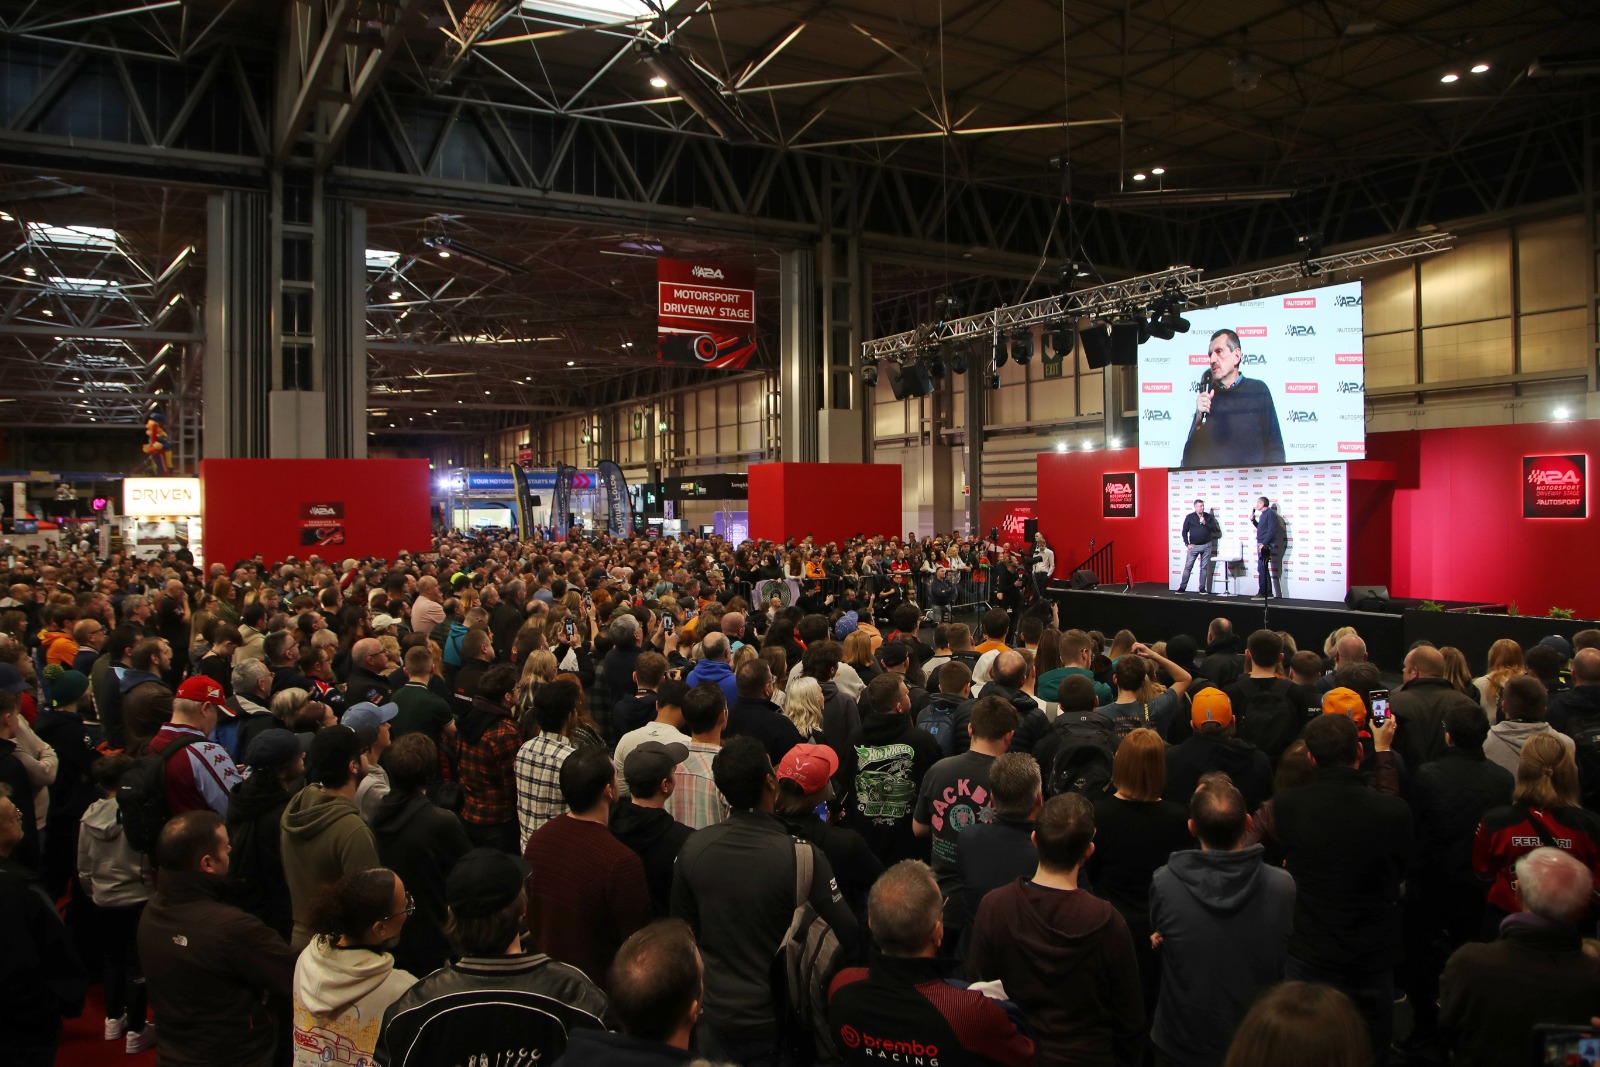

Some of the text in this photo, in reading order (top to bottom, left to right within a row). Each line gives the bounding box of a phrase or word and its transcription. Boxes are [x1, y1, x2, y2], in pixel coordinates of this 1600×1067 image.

[673, 288, 740, 304] MOTORSPORT
[663, 302, 750, 319] DRIVEWAY STAGE
[1046, 363, 1059, 375] EXIT
[132, 489, 192, 504] DRIVEN
[1538, 498, 1580, 506] AUTOSPORT
[1511, 836, 1572, 849] FERRI
[863, 1032, 938, 1057] brembo
[865, 1047, 939, 1067] RACING
